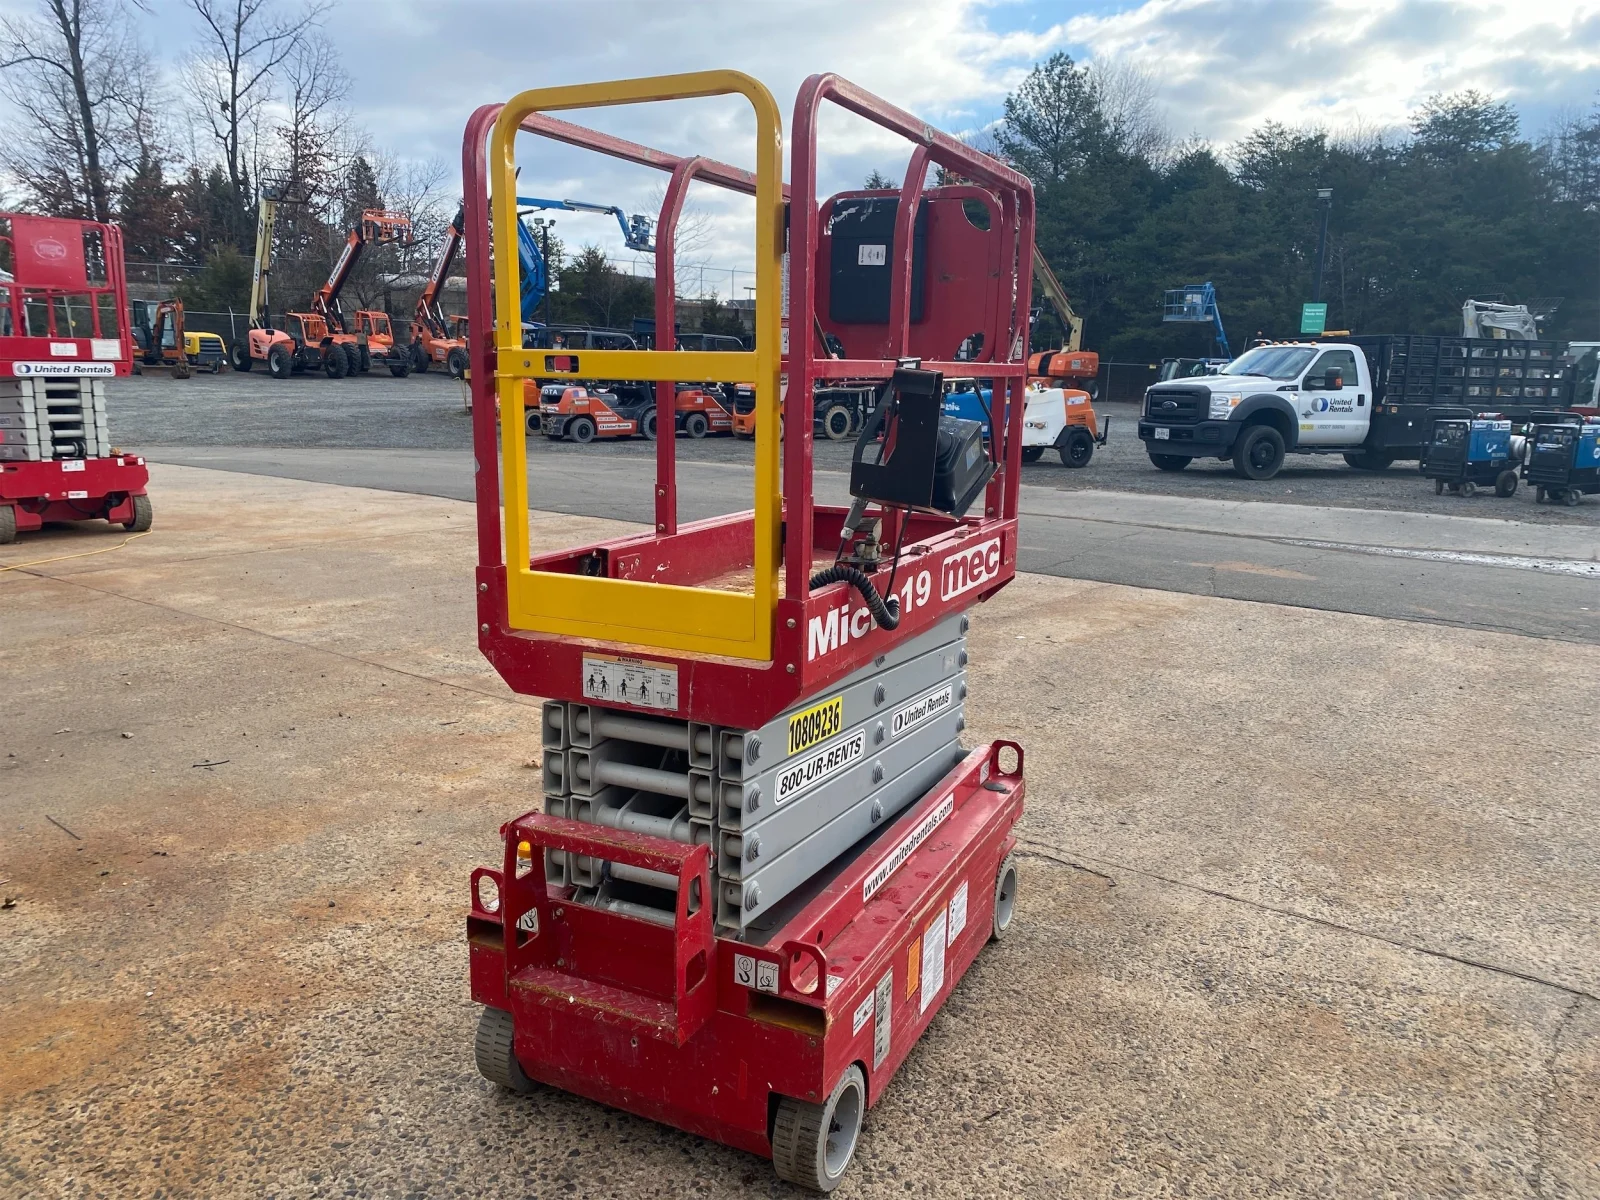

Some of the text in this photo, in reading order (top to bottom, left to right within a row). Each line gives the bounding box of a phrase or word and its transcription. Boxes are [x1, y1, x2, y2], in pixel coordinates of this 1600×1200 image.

[34, 365, 112, 374] United Rentals
[1329, 398, 1353, 406] United
[942, 543, 1000, 598] mec
[789, 701, 840, 752] 10809236
[903, 691, 950, 727] United Rentals
[780, 736, 862, 796] 800-UR-RENTS
[864, 800, 953, 898] www.unitedrentals.com
